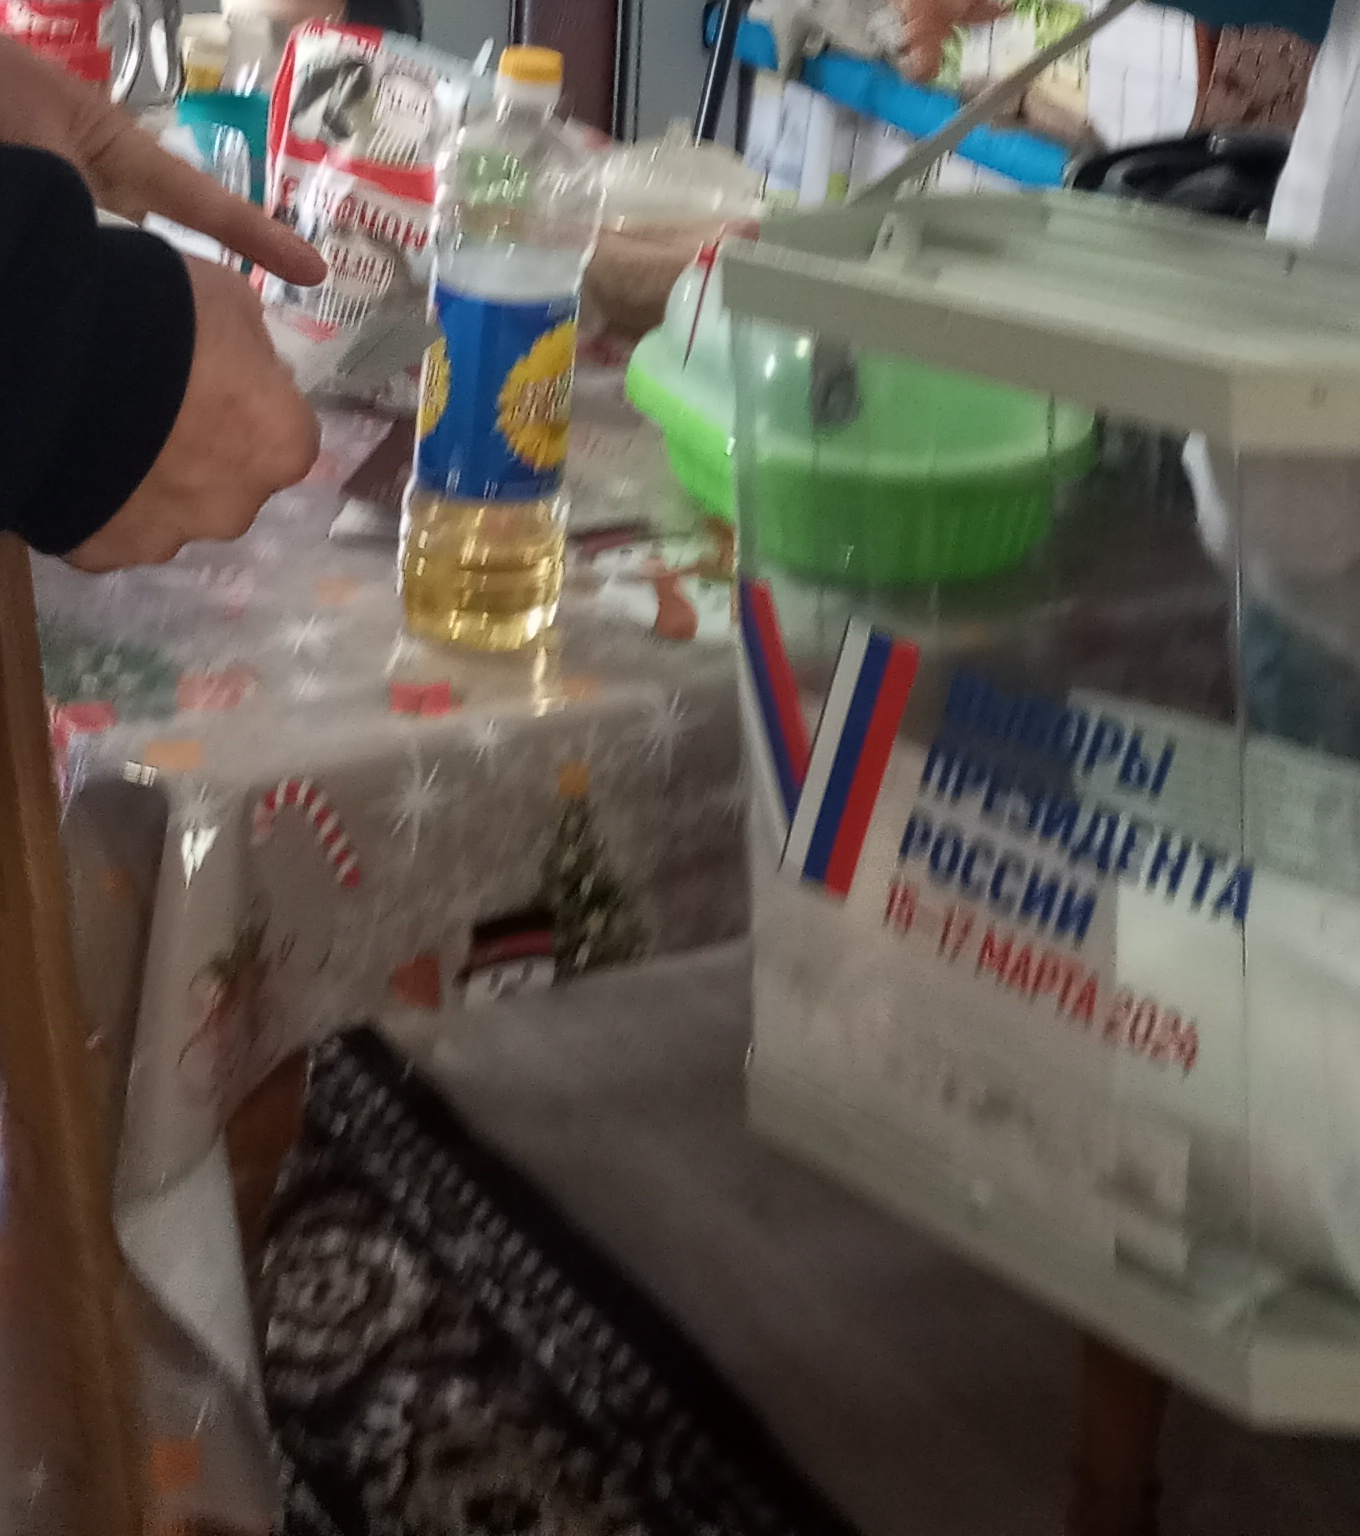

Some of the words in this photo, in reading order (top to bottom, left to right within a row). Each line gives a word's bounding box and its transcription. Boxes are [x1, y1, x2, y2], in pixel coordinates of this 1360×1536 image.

[898, 804, 1098, 948] РОССИИ
[920, 739, 1255, 932] ПРЕЗИДЕНТА
[976, 922, 1099, 1028] МАРТА
